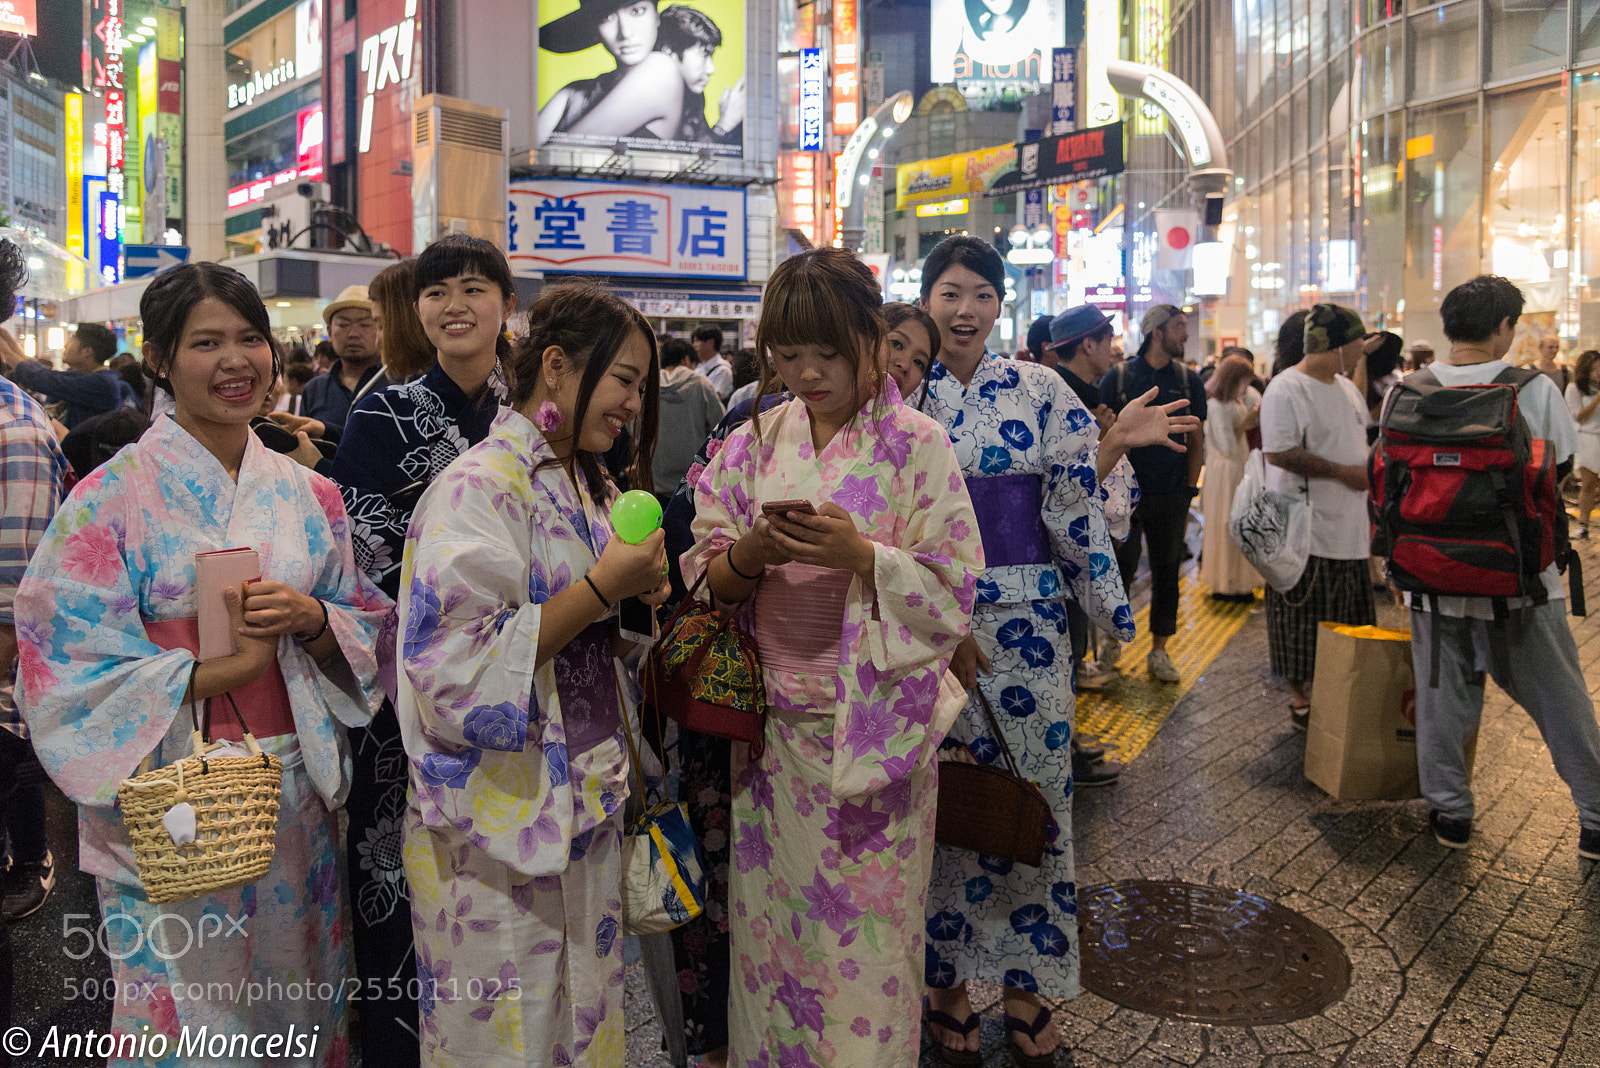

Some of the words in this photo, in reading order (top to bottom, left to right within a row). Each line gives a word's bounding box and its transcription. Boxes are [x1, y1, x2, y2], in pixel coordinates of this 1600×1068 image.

[160, 82, 180, 92] JTB
[228, 58, 294, 108] Euphoria
[678, 262, 702, 271] BOOKS
